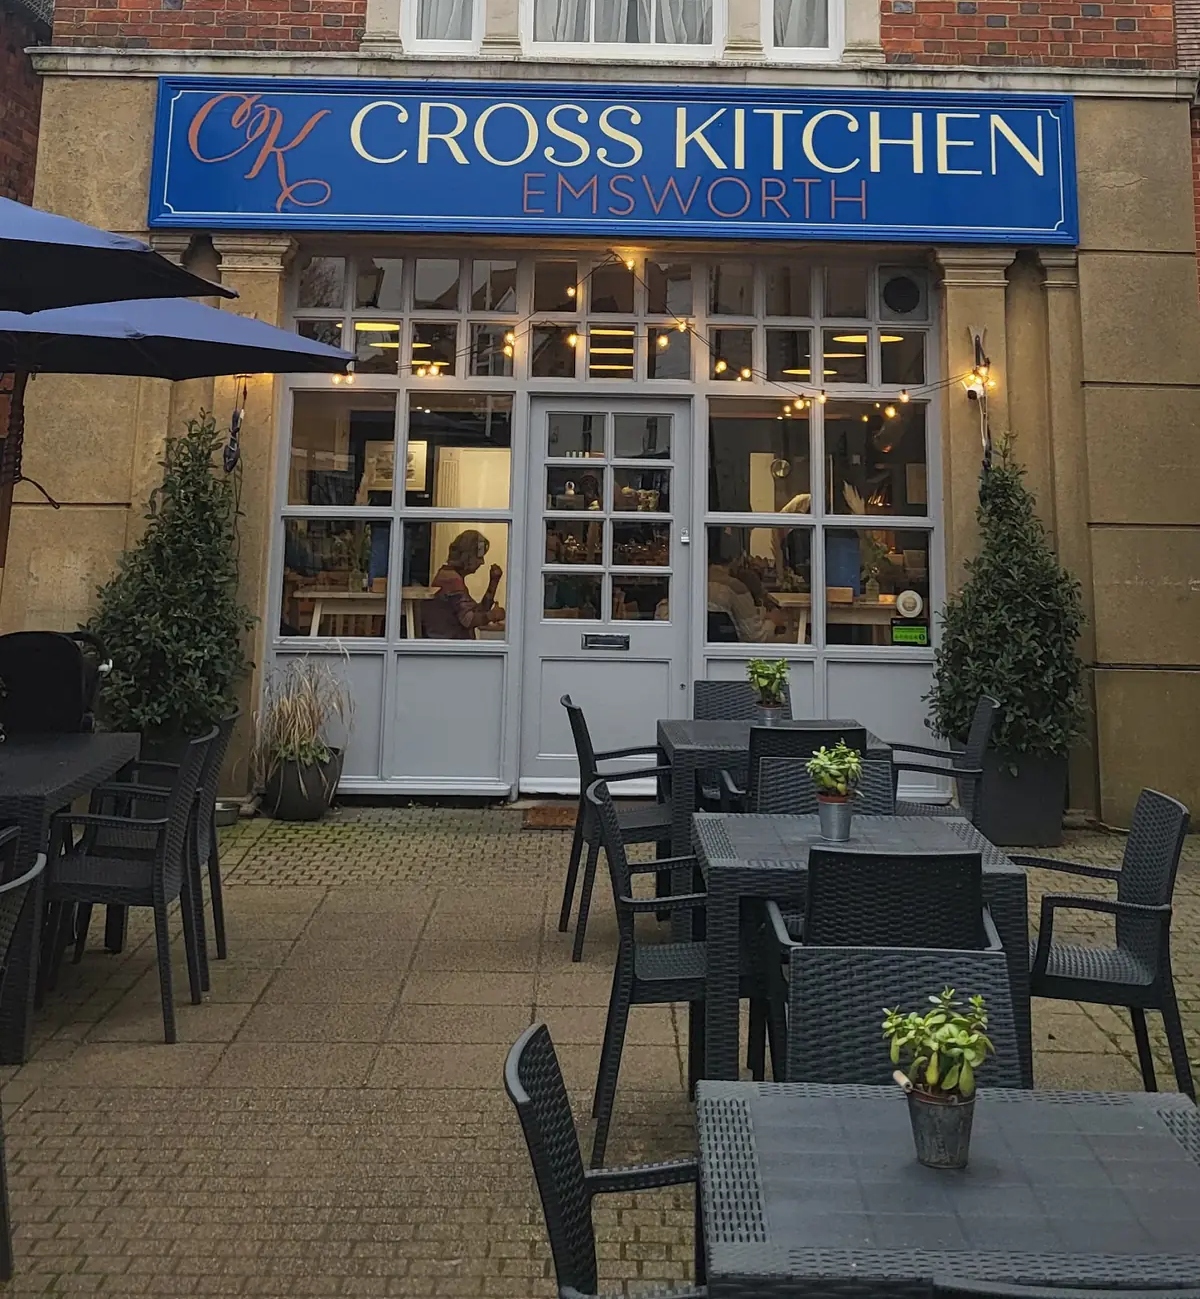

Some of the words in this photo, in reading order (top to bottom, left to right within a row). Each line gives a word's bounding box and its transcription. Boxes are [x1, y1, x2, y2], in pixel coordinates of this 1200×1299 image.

[350, 101, 644, 168] CROSS
[676, 107, 1044, 177] KITCHEN
[522, 173, 867, 220] EMSWORTH
